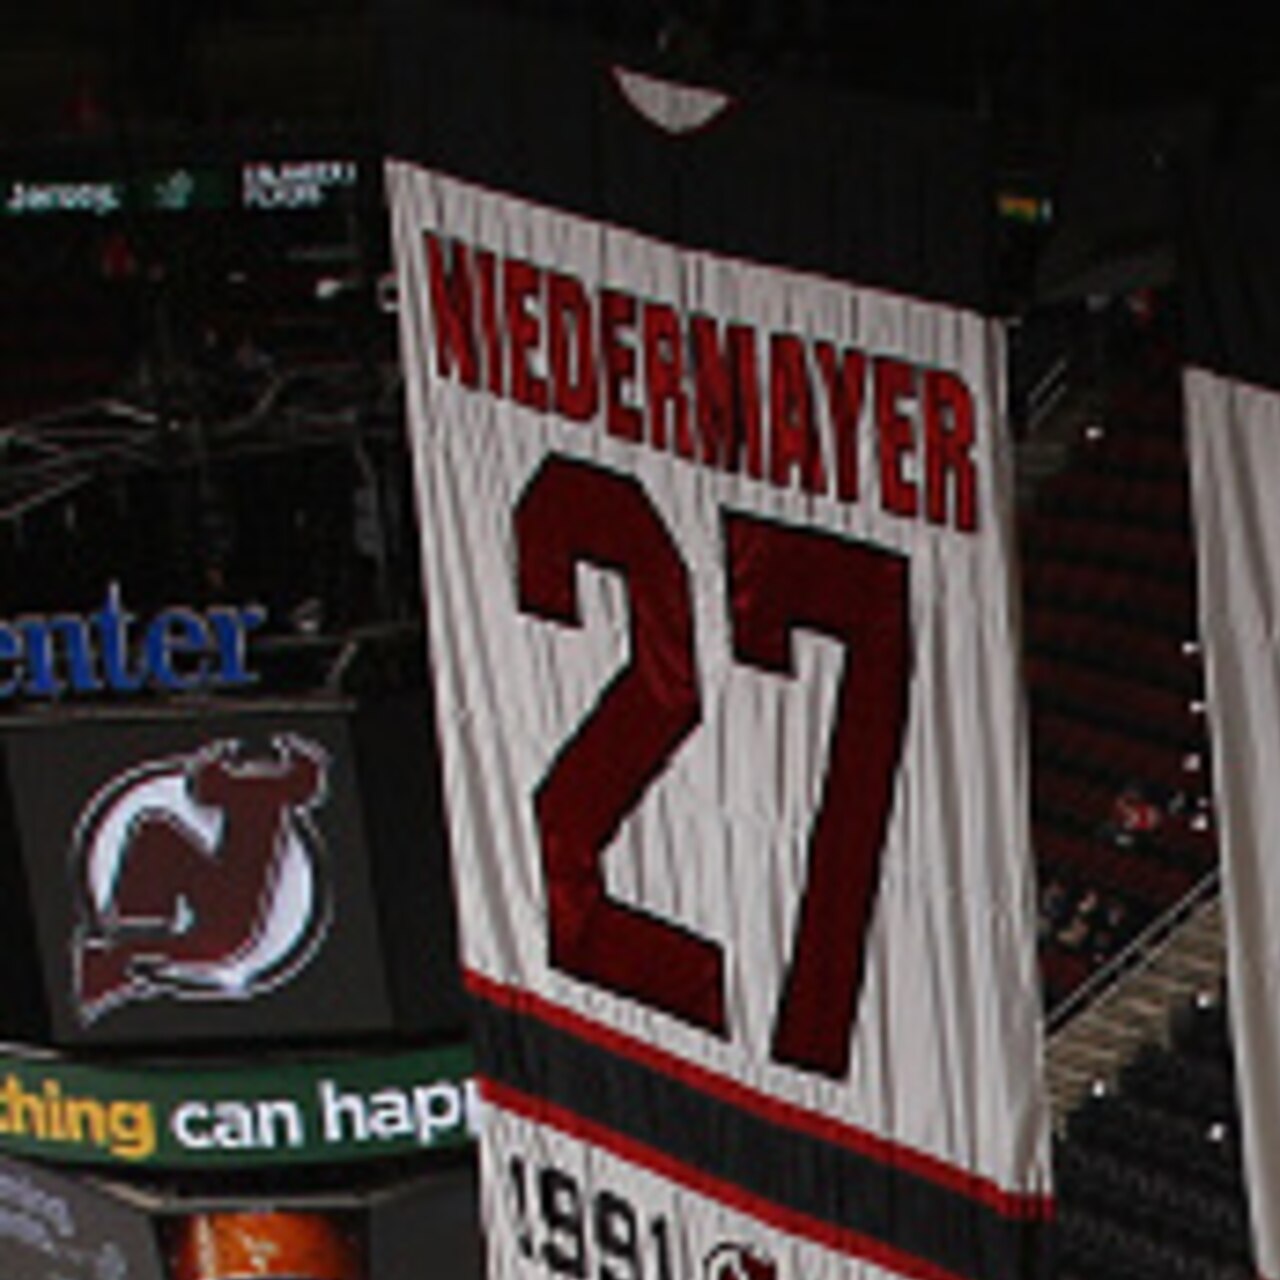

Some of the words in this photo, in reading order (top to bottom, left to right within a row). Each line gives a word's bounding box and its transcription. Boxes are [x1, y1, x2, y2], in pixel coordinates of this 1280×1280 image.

[424, 231, 977, 534] NIEDERMAYER
[512, 453, 911, 1080] 27
[170, 1097, 303, 1149] can
